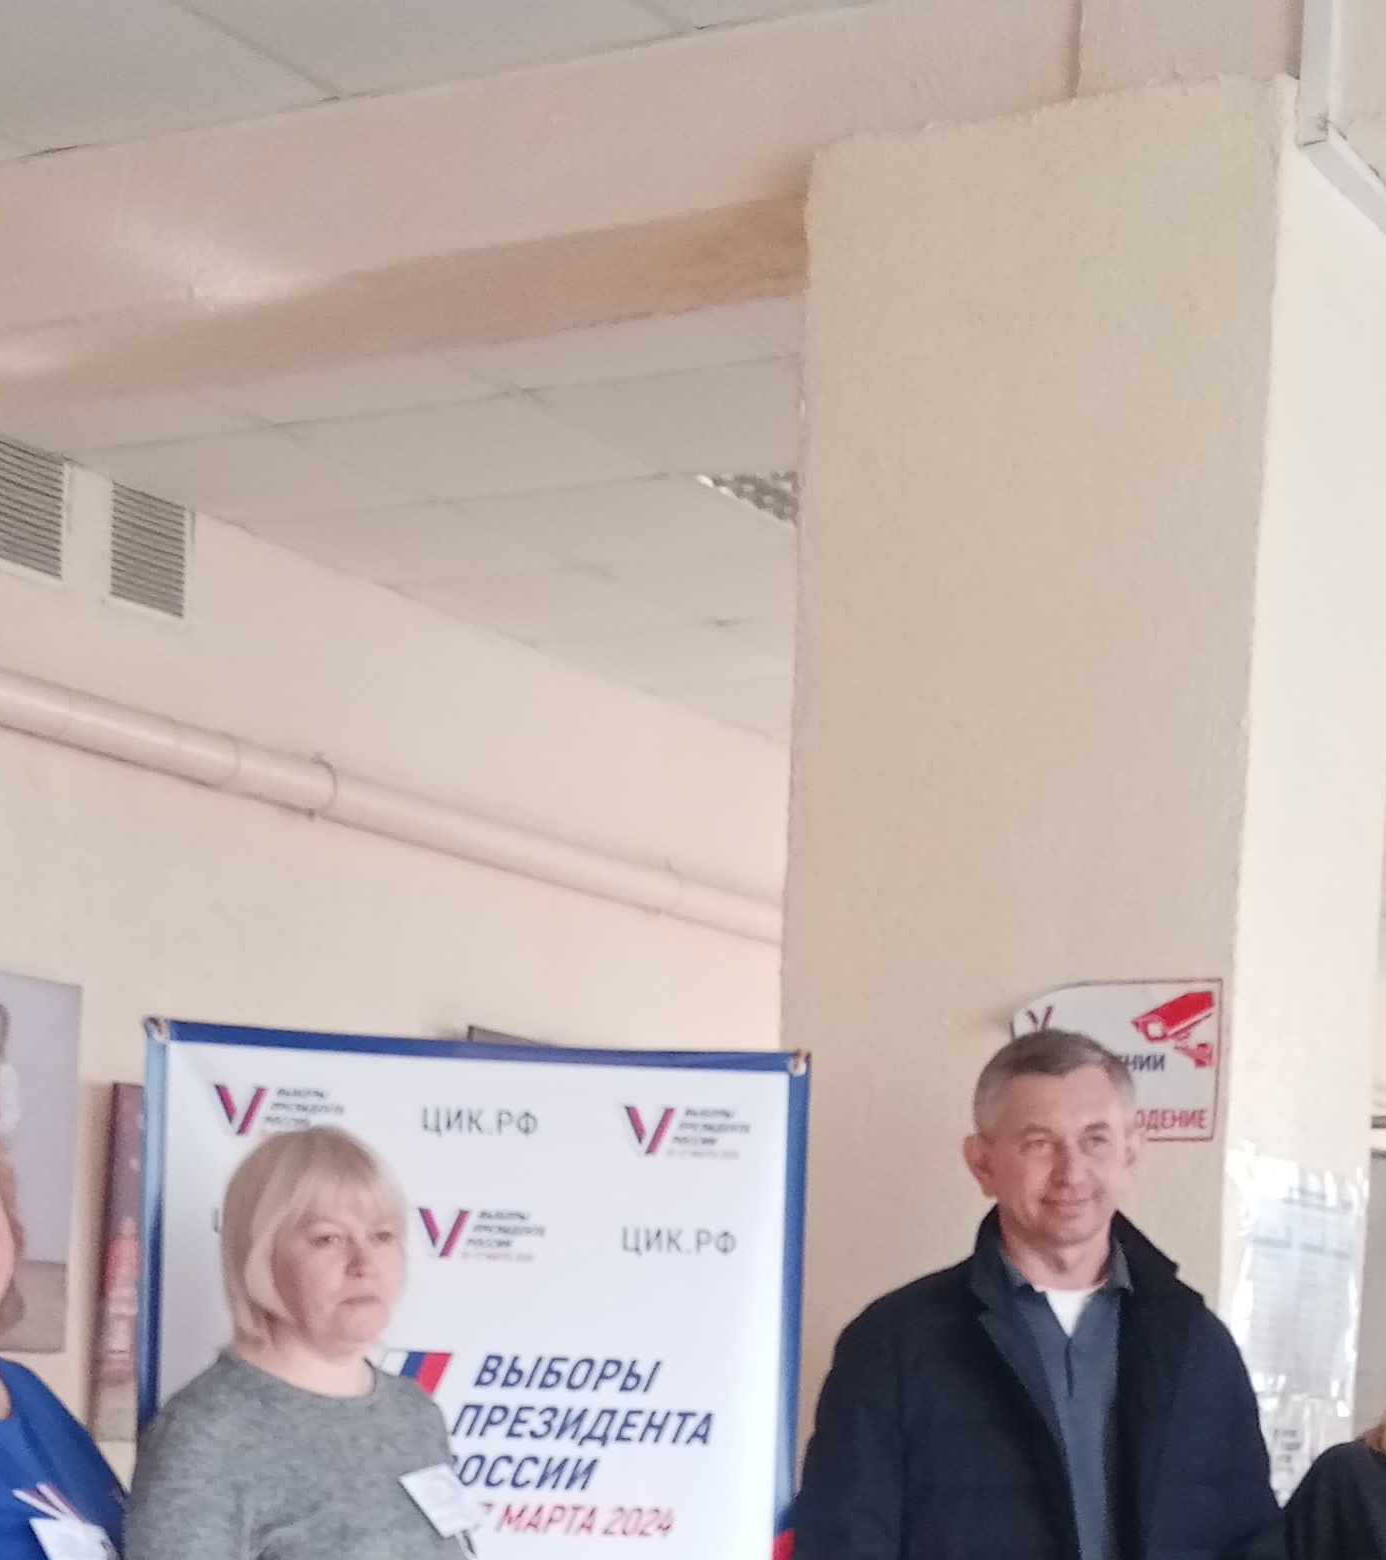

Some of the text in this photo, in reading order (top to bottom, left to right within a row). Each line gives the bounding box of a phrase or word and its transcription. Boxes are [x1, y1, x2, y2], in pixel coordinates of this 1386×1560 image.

[422, 1105, 538, 1136] ЦИК.РФ
[622, 1226, 737, 1258] ЦИК.РФ
[474, 1354, 661, 1394] ВЫБОРЫ
[451, 1404, 714, 1447] ПРЕЗИДЕНТА
[452, 1454, 600, 1491] ОССИИ
[496, 1503, 597, 1534] МАРТА
[603, 1506, 676, 1538] 2024
